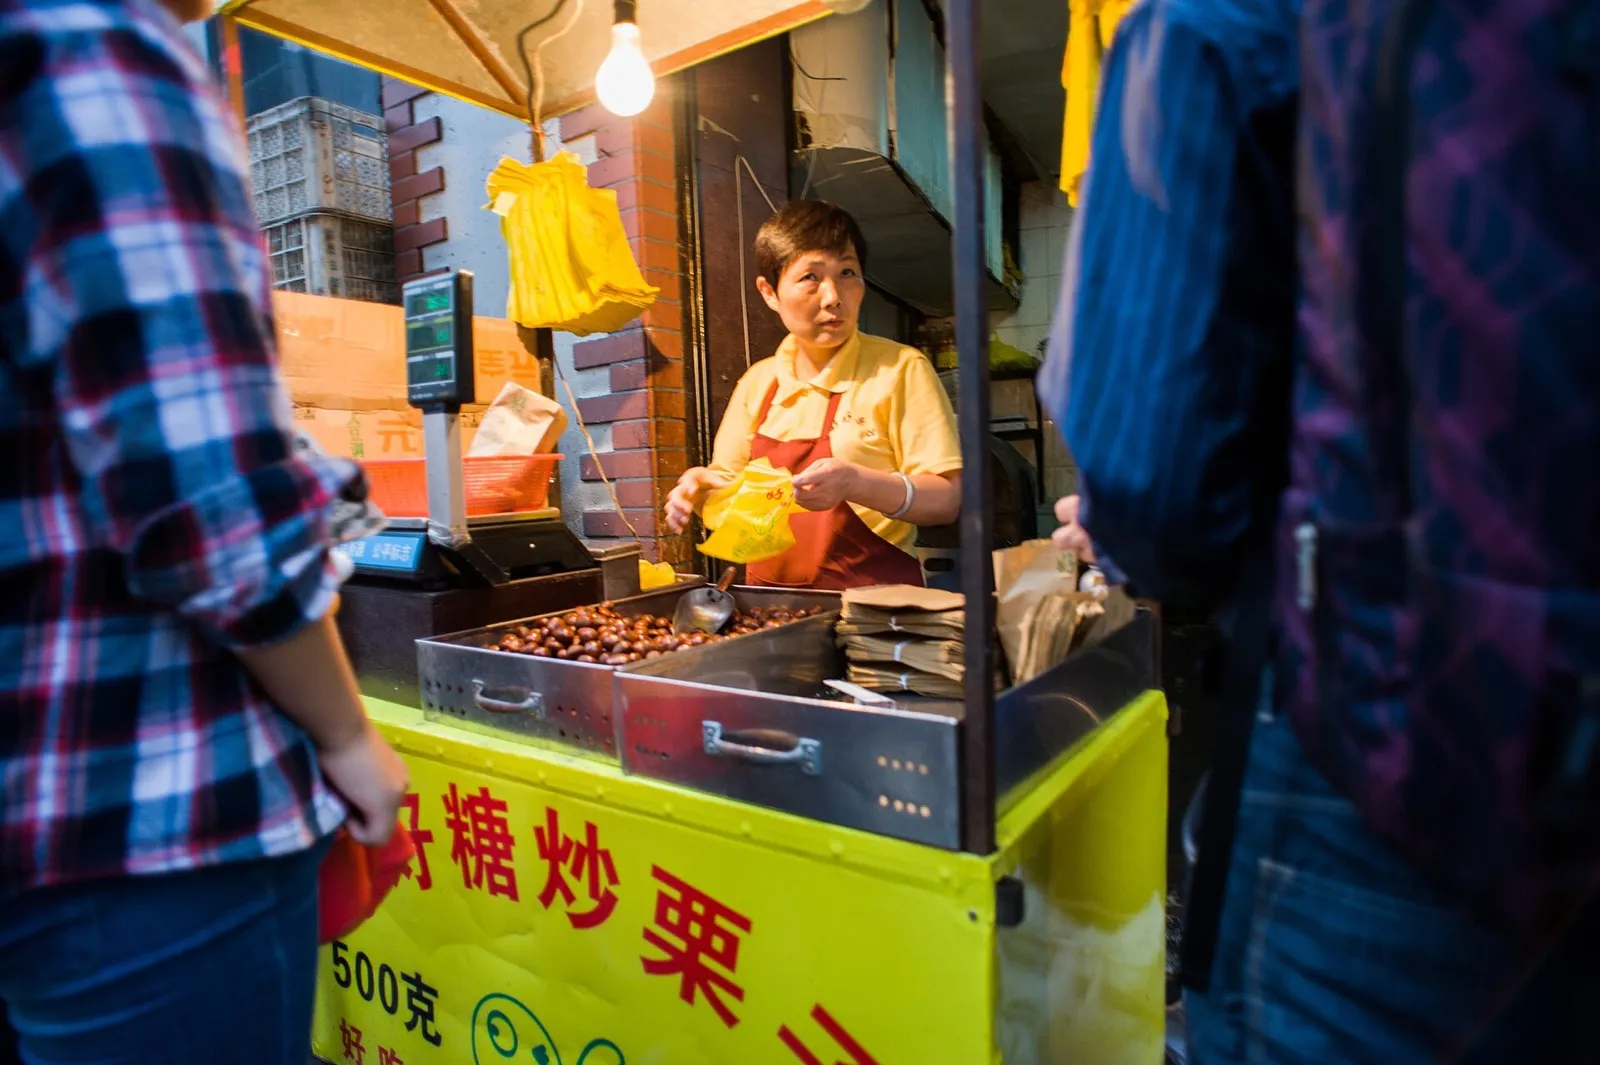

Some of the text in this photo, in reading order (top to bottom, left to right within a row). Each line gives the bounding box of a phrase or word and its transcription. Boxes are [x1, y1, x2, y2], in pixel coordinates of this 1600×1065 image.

[332, 940, 442, 1047] 500克
[394, 782, 882, 1065] 糖炒栗
